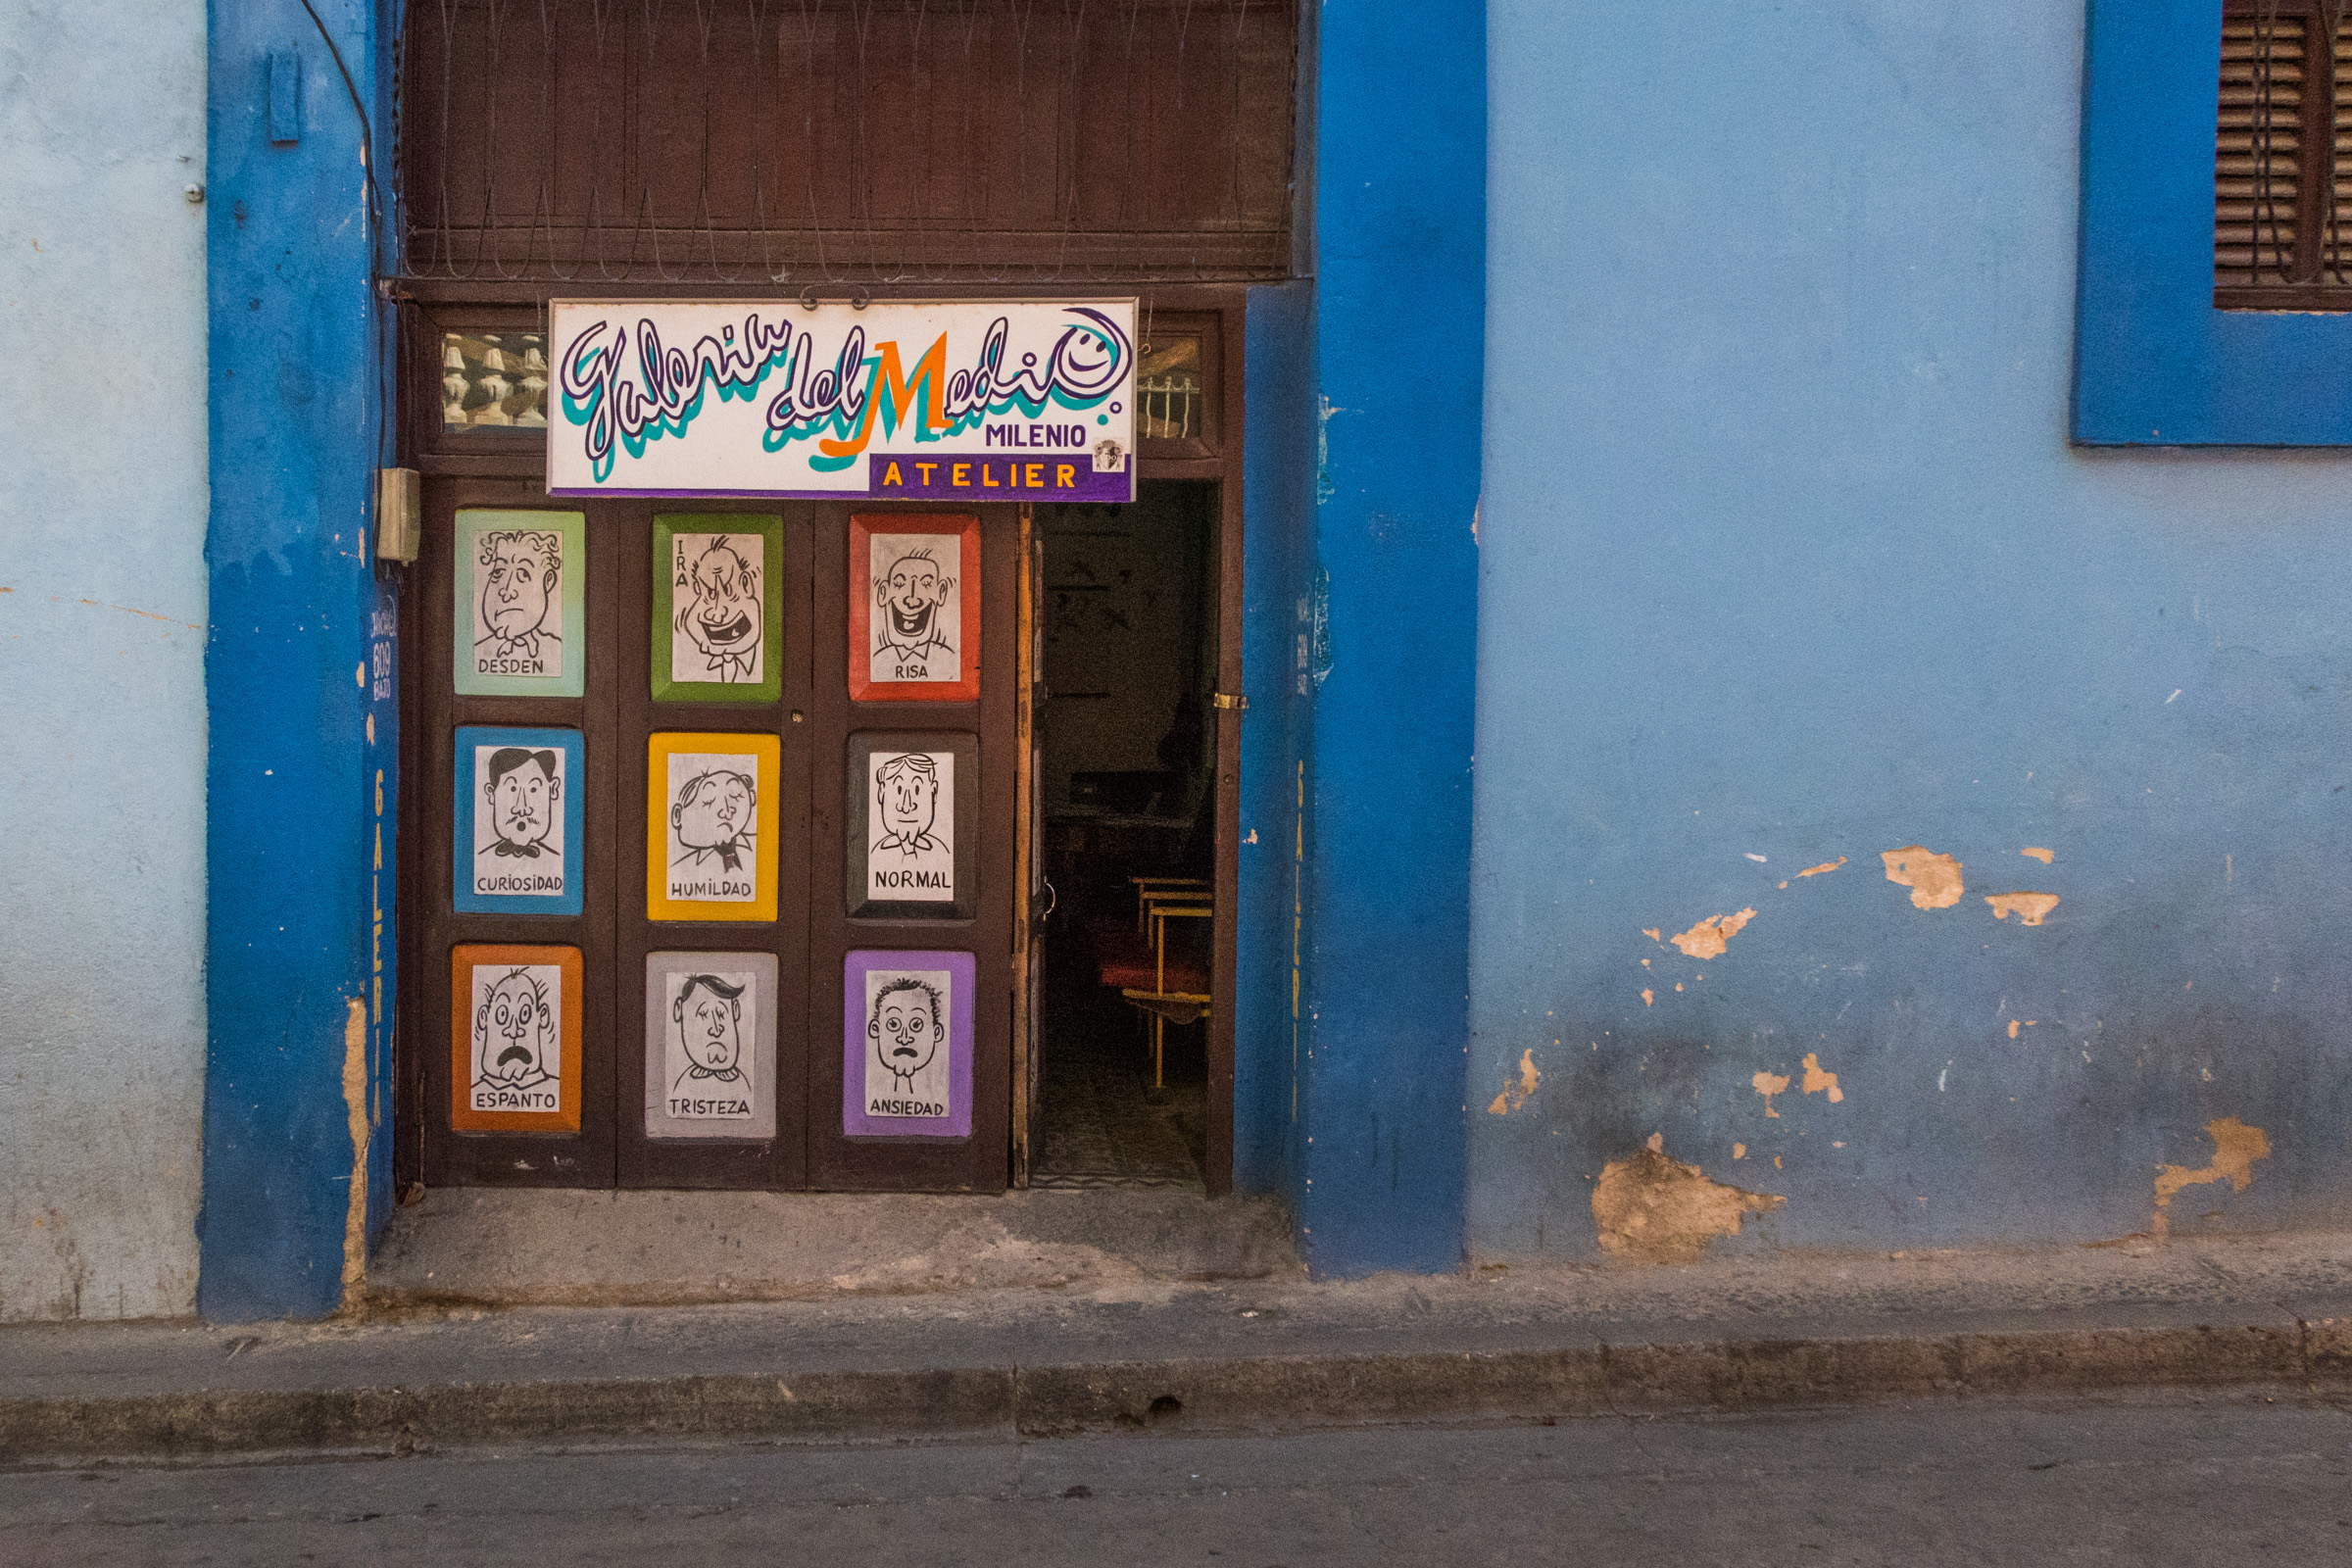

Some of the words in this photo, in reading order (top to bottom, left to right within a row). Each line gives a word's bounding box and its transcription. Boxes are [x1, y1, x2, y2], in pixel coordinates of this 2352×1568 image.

[766, 324, 865, 431] del
[985, 423, 1087, 448] MILENIO
[882, 462, 1076, 489] ATELIER
[674, 539, 689, 588] IRA
[372, 641, 391, 680] 609
[477, 658, 544, 675] DESDEN
[894, 663, 929, 679] RISA
[874, 869, 952, 890] NORMAL
[475, 1091, 557, 1109] ESPANTO
[669, 1097, 752, 1116] TRISTEZA
[869, 1098, 945, 1117] ANSIEDAD
